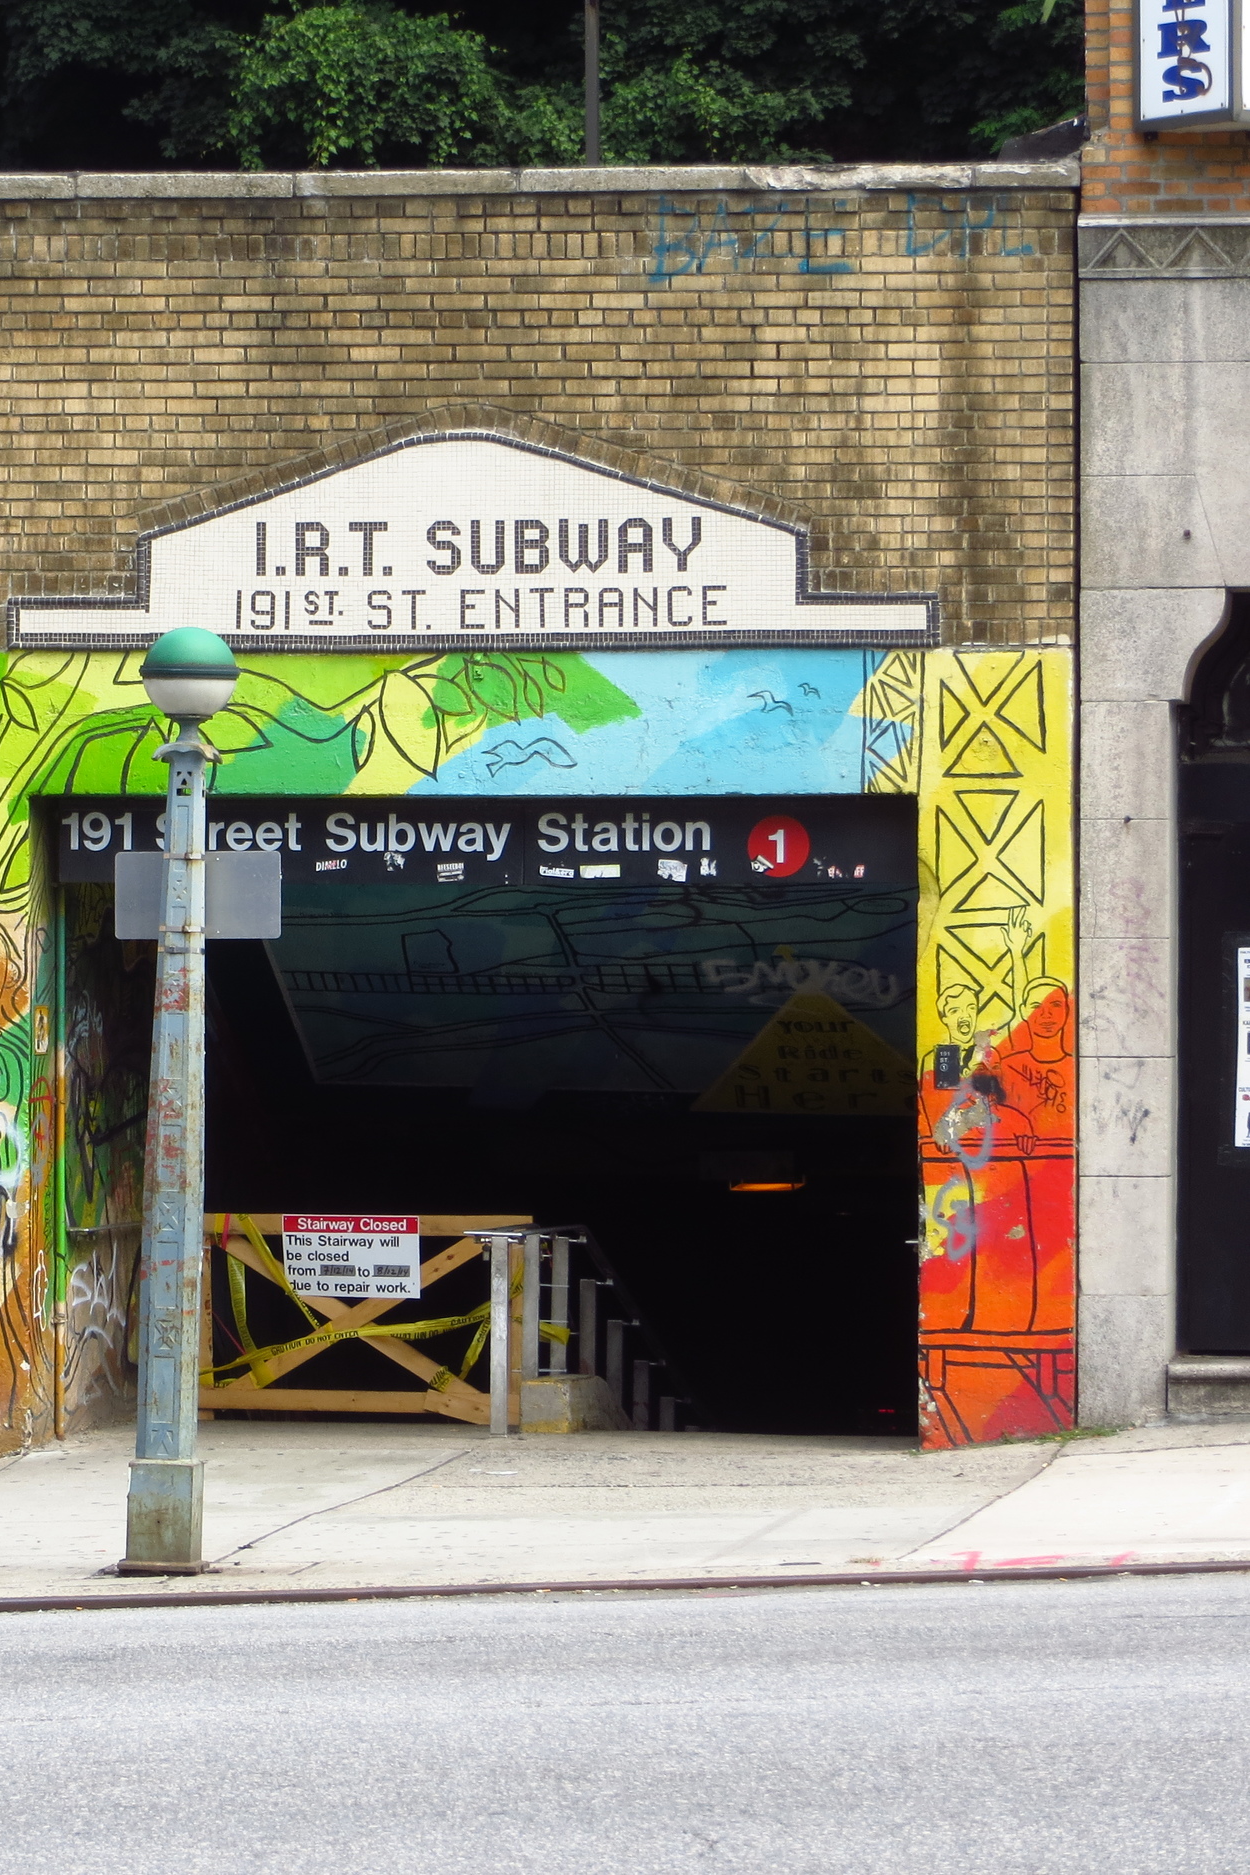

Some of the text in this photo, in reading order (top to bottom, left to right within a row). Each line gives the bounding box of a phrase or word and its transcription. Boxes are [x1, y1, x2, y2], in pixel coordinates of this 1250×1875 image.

[255, 516, 703, 577] I.R.T. SUBWAY
[366, 589, 432, 631] ST.
[459, 585, 729, 630] ENTRANCE
[61, 811, 134, 852] 191
[154, 812, 303, 852] reet
[325, 812, 512, 862] Subway
[537, 812, 711, 852] Station
[768, 829, 785, 864] 1
[297, 1217, 407, 1233] Stairway Closed
[286, 1235, 400, 1249] This Stairway will
[286, 1250, 350, 1262] be closed
[288, 1265, 316, 1276] from
[358, 1265, 370, 1278] to
[317, 1281, 329, 1291] to
[335, 1282, 371, 1296] repair
[376, 1283, 411, 1293] work.
